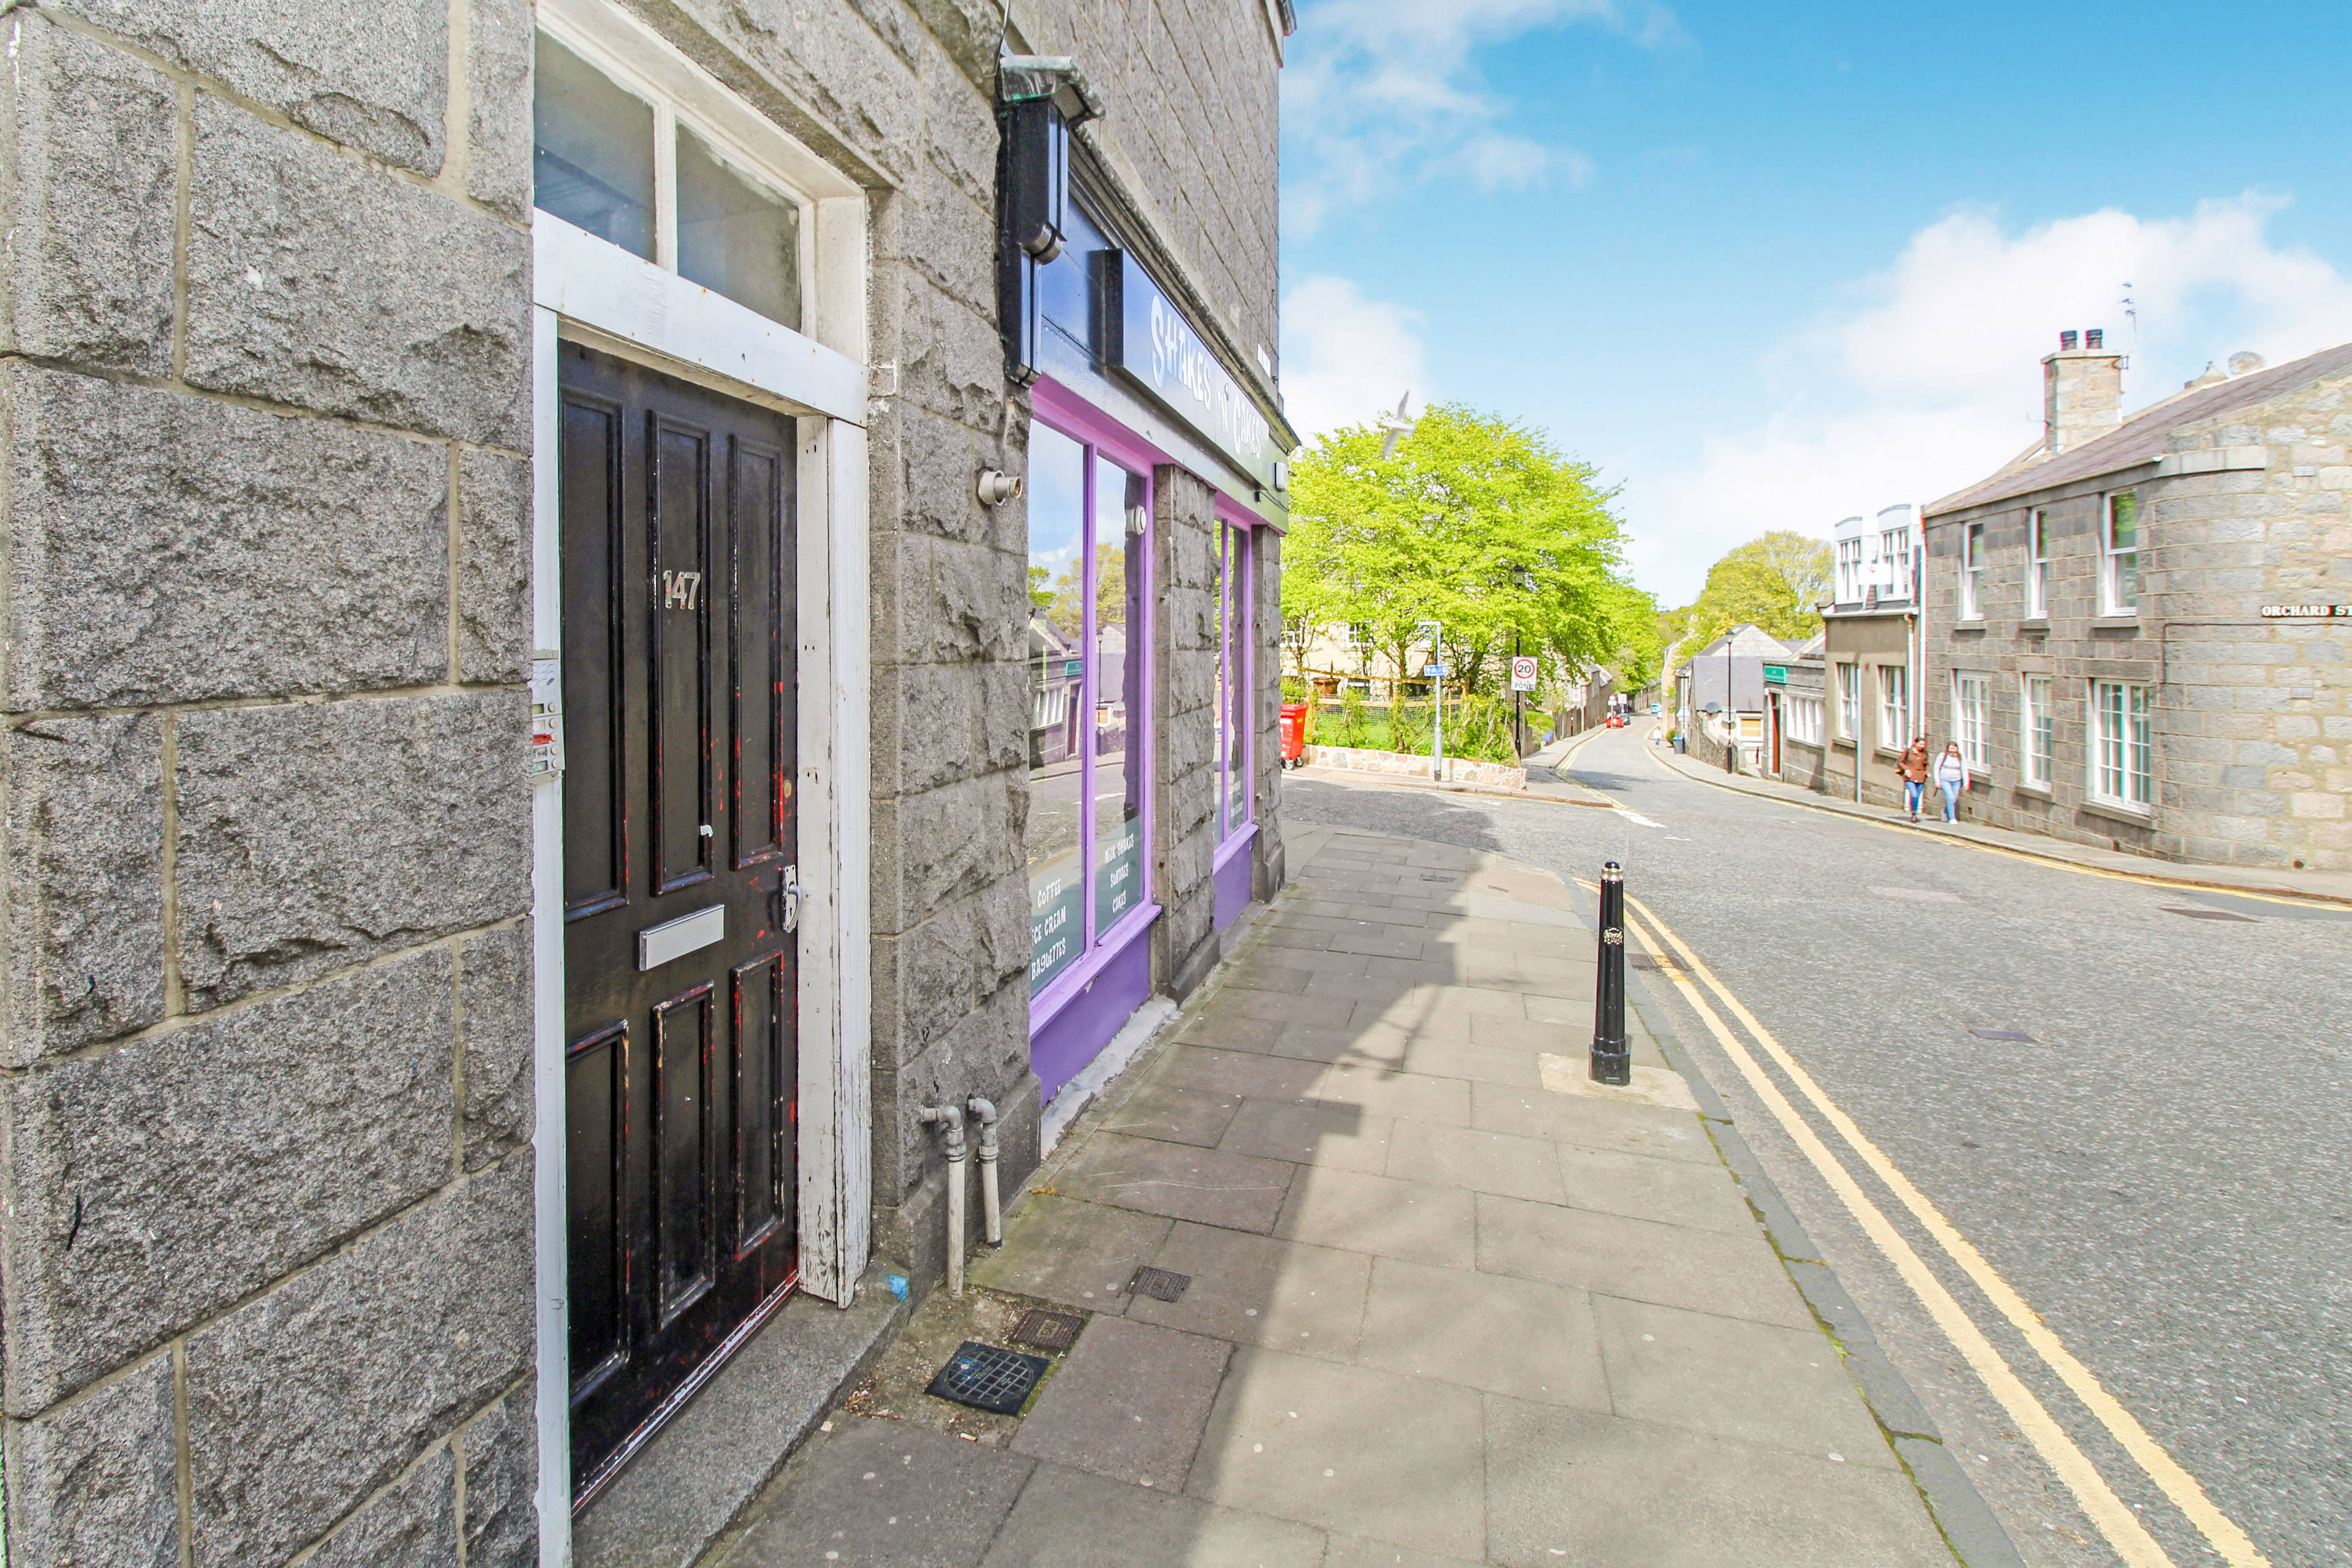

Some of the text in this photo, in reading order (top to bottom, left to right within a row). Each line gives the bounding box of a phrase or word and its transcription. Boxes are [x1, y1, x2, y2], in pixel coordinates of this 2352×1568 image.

[663, 570, 701, 609] 147
[2261, 605, 2331, 616] ORCHARD
[1518, 665, 1531, 673] 20
[1044, 905, 1066, 937] CREAM
